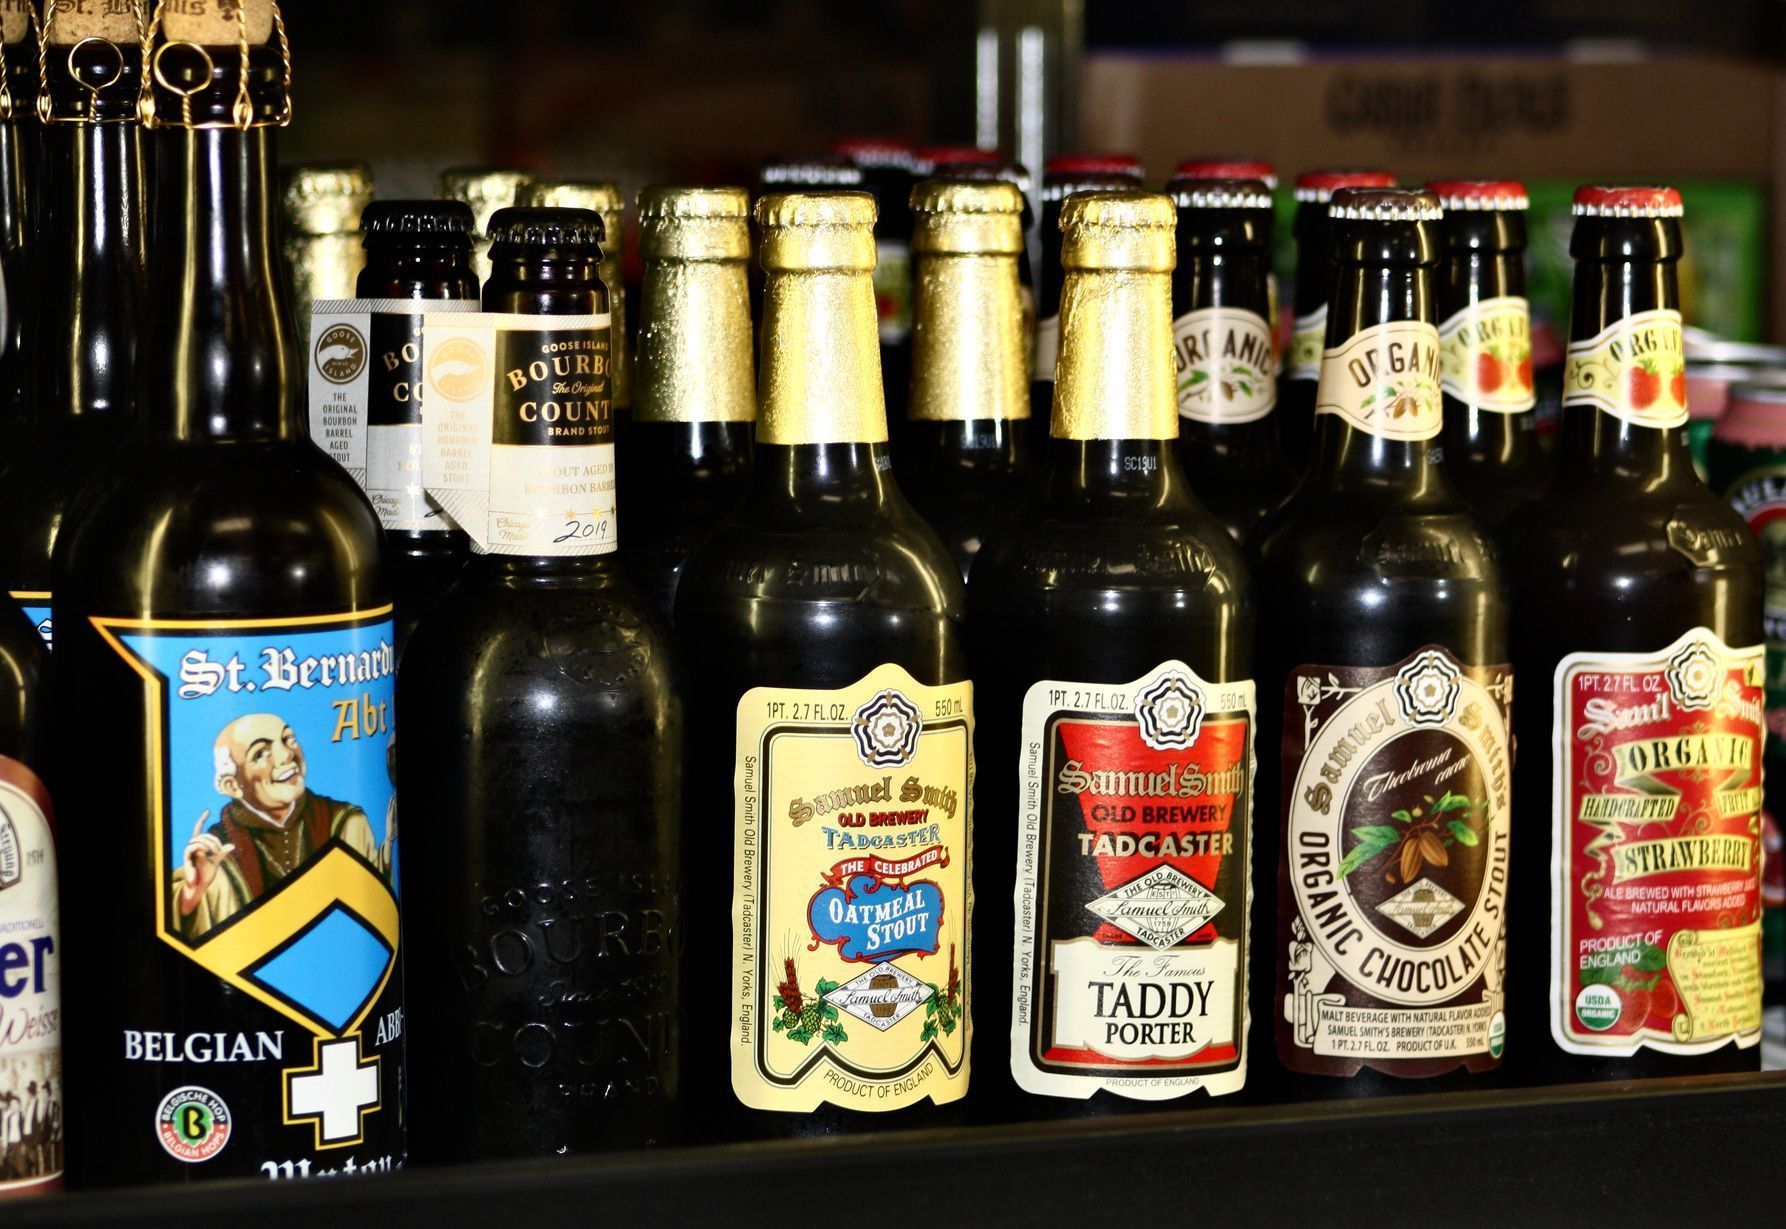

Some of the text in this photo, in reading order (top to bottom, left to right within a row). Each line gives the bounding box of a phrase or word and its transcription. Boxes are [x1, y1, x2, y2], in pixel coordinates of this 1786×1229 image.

[326, 330, 356, 343] GOOSE
[541, 340, 580, 354] GOOSE
[324, 363, 357, 378] ISLAND
[333, 392, 347, 402] THE
[551, 380, 606, 397] The Original
[322, 404, 358, 415] ORIGINAL
[322, 417, 358, 427] BOURBON
[547, 426, 585, 437] BRAND
[325, 429, 353, 439] BARREL
[329, 441, 349, 451] AGED
[331, 453, 350, 463] TOUT
[583, 464, 608, 477] AGED
[553, 519, 608, 544] 2019
[178, 648, 255, 700] St.
[1603, 675, 1620, 692] 2.7
[1622, 675, 1641, 692] FL.
[1643, 675, 1662, 692] OZ.
[935, 698, 952, 716] 550
[1048, 689, 1070, 708] 1PT.
[1074, 691, 1091, 709] 2.7
[1220, 693, 1236, 710] 550
[331, 692, 388, 743] Abt
[766, 702, 789, 719] 1PT.
[792, 703, 811, 720] 2.7
[1029, 741, 1041, 777] Samuel
[1303, 698, 1396, 816] Samuel
[1057, 759, 1245, 800] Samuel Smith
[1363, 747, 1453, 803] Theobroma
[788, 776, 958, 828] Samuel Smith
[1027, 781, 1040, 811] Smith
[1090, 804, 1229, 824] OLD BREWERY
[1583, 797, 1676, 818] HANDCRAFTED
[837, 809, 930, 828] OLD BREWERY
[1026, 813, 1038, 831] Old
[821, 823, 942, 850] TADCASTER
[1077, 831, 1234, 858] TADCASTER
[840, 850, 938, 877] THE CELEBRATED
[1023, 833, 1037, 874] Brewery
[1624, 839, 1749, 875] STRAWBERRY
[1124, 871, 1203, 897] THE OLD BREWERY
[1603, 880, 1744, 900] ALE BREWED WITH STRAWBERRY
[739, 755, 757, 1047] Samuel Smith Old Brewery (Tadcaster) N. Yorks, England.
[1022, 876, 1036, 933] (Tadcaster)
[1108, 900, 1211, 916] Samuel Smith
[1631, 893, 1747, 914] NATURAL FLAVORS ADDED
[1299, 831, 1508, 995] ORGANIC CHOCOLATE STOUT
[866, 912, 930, 951] STOUT
[1136, 927, 1186, 948] TADCASTER
[1579, 929, 1664, 954] PRODUCT OF
[1019, 950, 1033, 981] Yorks,
[1103, 954, 1206, 978] The Famous
[1579, 949, 1642, 970] ENGLAND
[855, 966, 913, 986] THE OLD BREWERY
[843, 985, 922, 1005] Samuel Smith
[1018, 984, 1031, 1027] England.
[1087, 980, 1215, 1019] TADDY
[1585, 995, 1611, 1006] USDA
[863, 1012, 901, 1027] TADCASTER
[1321, 1010, 1343, 1022] MALT
[1345, 1011, 1389, 1024] BEVERAGE
[1390, 1011, 1412, 1024] WITH
[1413, 1011, 1447, 1023] NATURAL
[1448, 1009, 1472, 1021] FLAVOR
[1105, 1022, 1197, 1046] PORTER
[1327, 1025, 1358, 1037] SAMUEL
[1359, 1026, 1390, 1038] SMITH'S
[1391, 1026, 1426, 1038] BREWERY
[123, 1029, 285, 1063] BELGIAN
[1337, 1039, 1348, 1050] PT.
[1350, 1040, 1362, 1051] 2.7
[1363, 1040, 1375, 1051] FL.
[1376, 1040, 1390, 1052] OZ.
[1396, 1040, 1432, 1052] PRODUCT
[1433, 1039, 1444, 1051] OF
[823, 1061, 935, 1098] PRODUCT OF ENGLAND
[1105, 1077, 1200, 1088] PRODUCT OF ENGLAND
[208, 1099, 227, 1123] HOP
[163, 1131, 225, 1158] BELGIAN HOPS
